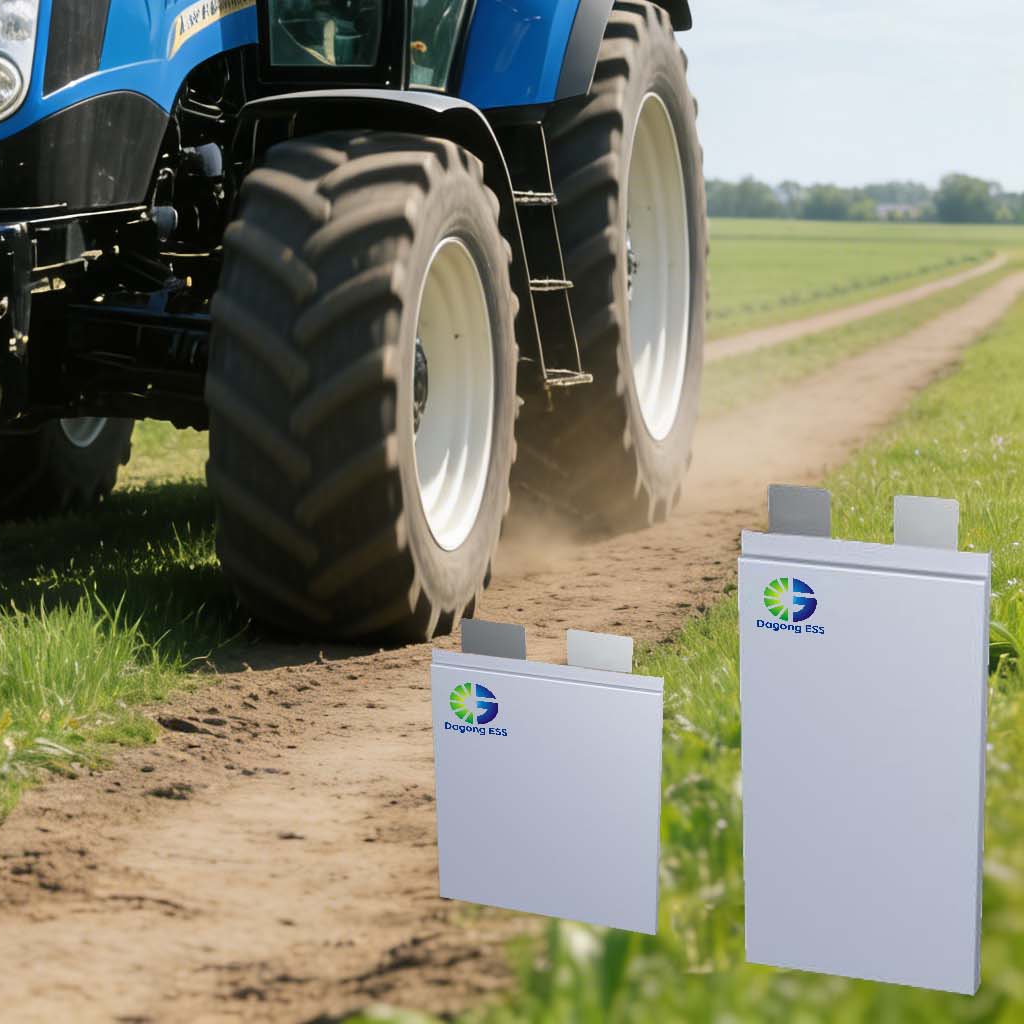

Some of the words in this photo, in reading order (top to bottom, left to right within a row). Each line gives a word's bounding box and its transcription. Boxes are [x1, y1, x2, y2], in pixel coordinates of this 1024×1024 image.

[756, 619, 802, 634] Dagong
[805, 624, 825, 635] ESS
[444, 721, 486, 736] Dagong
[488, 727, 508, 737] ESS
